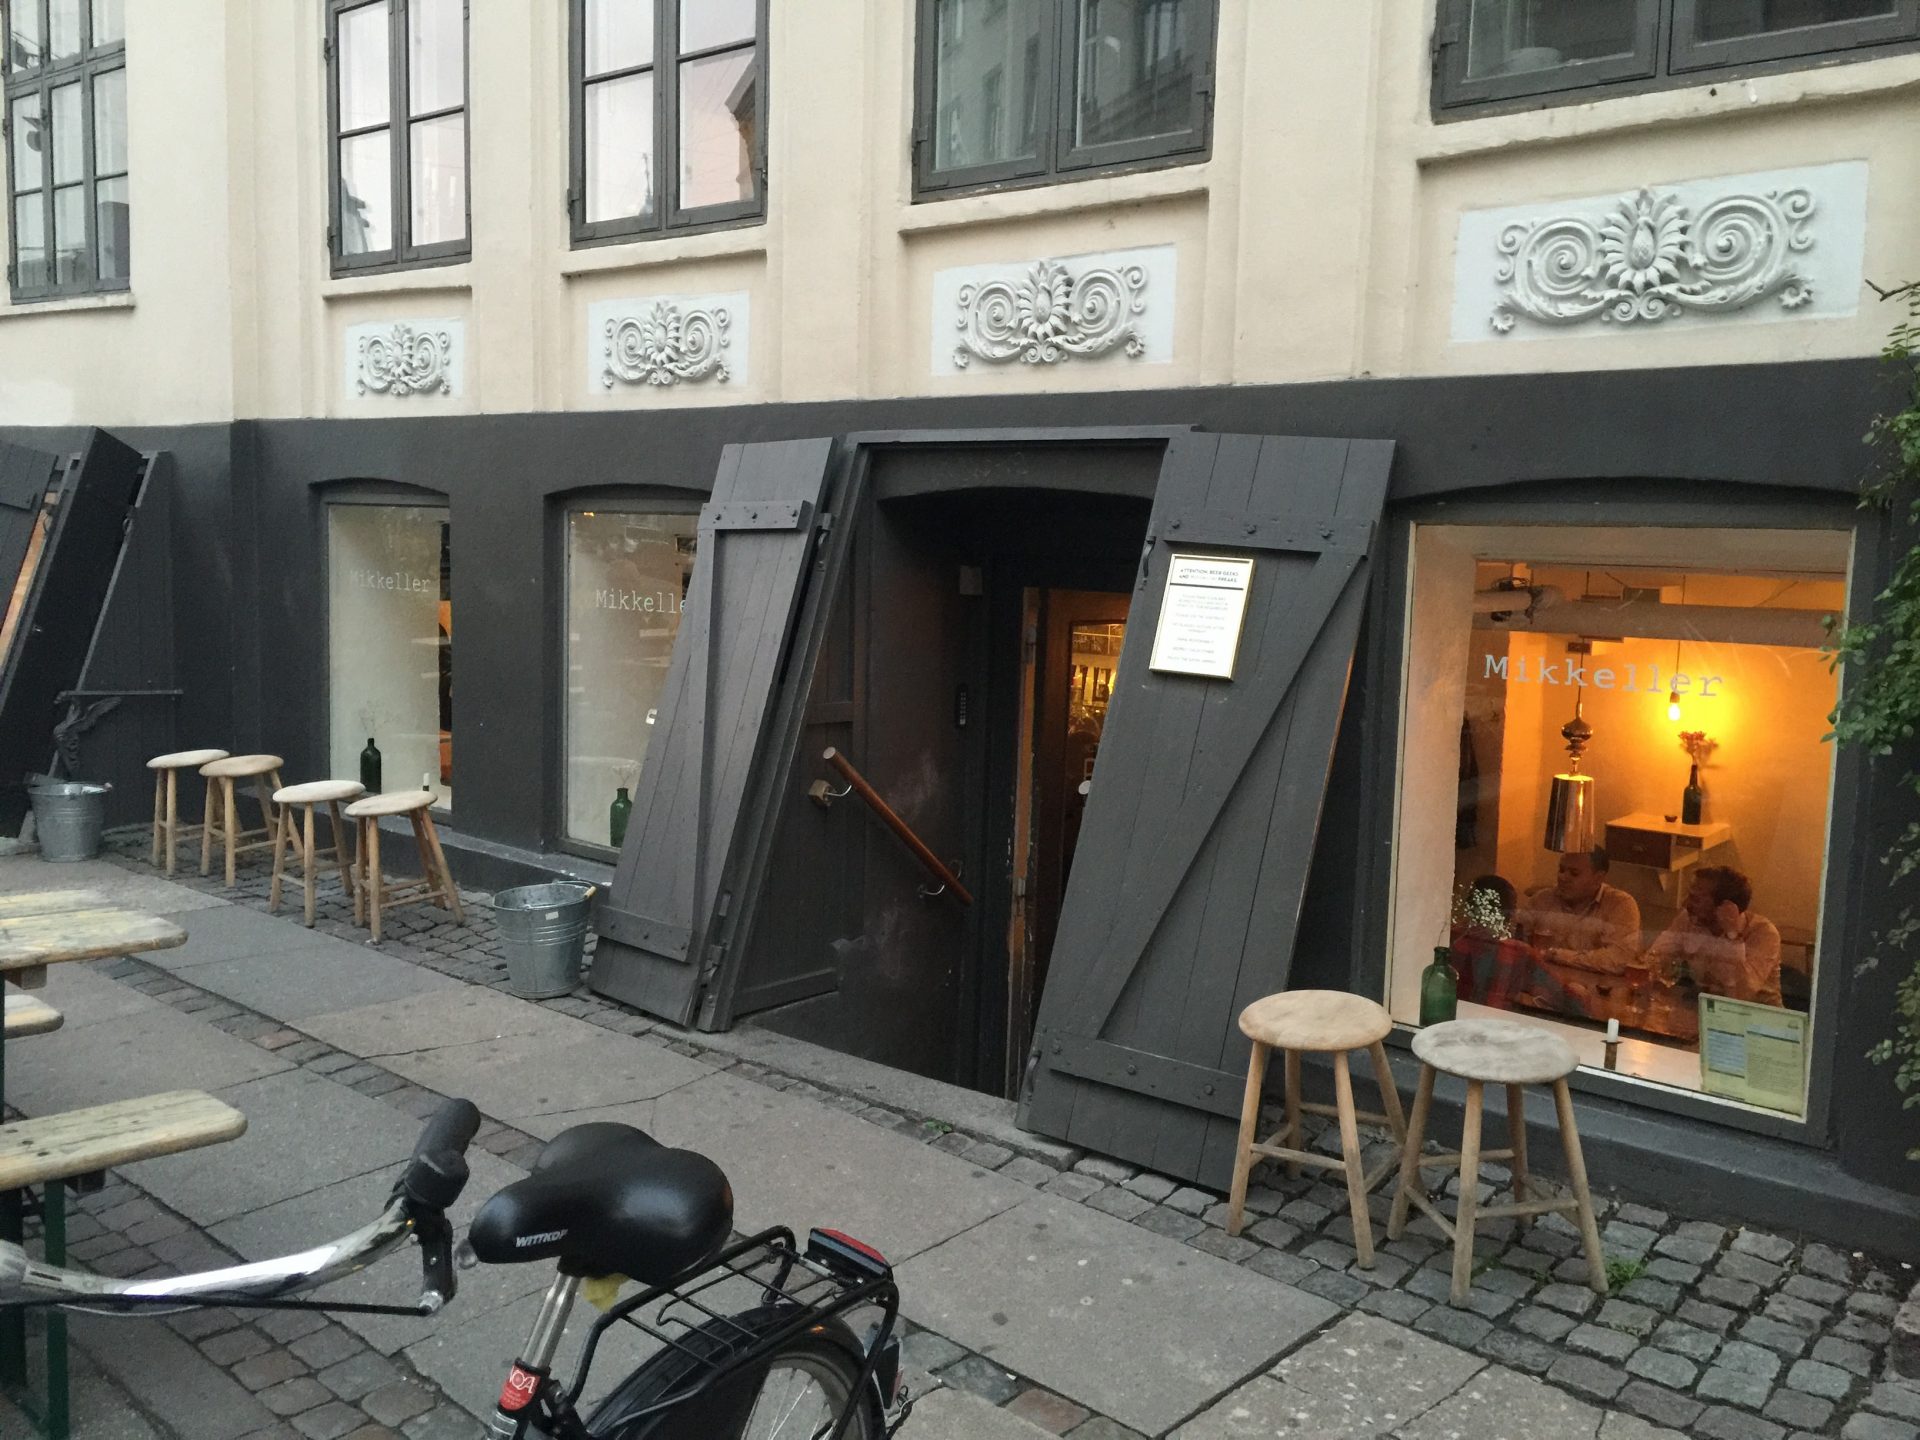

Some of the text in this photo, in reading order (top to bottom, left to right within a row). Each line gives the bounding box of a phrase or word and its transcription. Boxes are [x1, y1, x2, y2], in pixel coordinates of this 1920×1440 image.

[350, 569, 431, 593] Mikkeller
[595, 588, 687, 614] Mikkelle
[1483, 654, 1725, 697] Mikkeller
